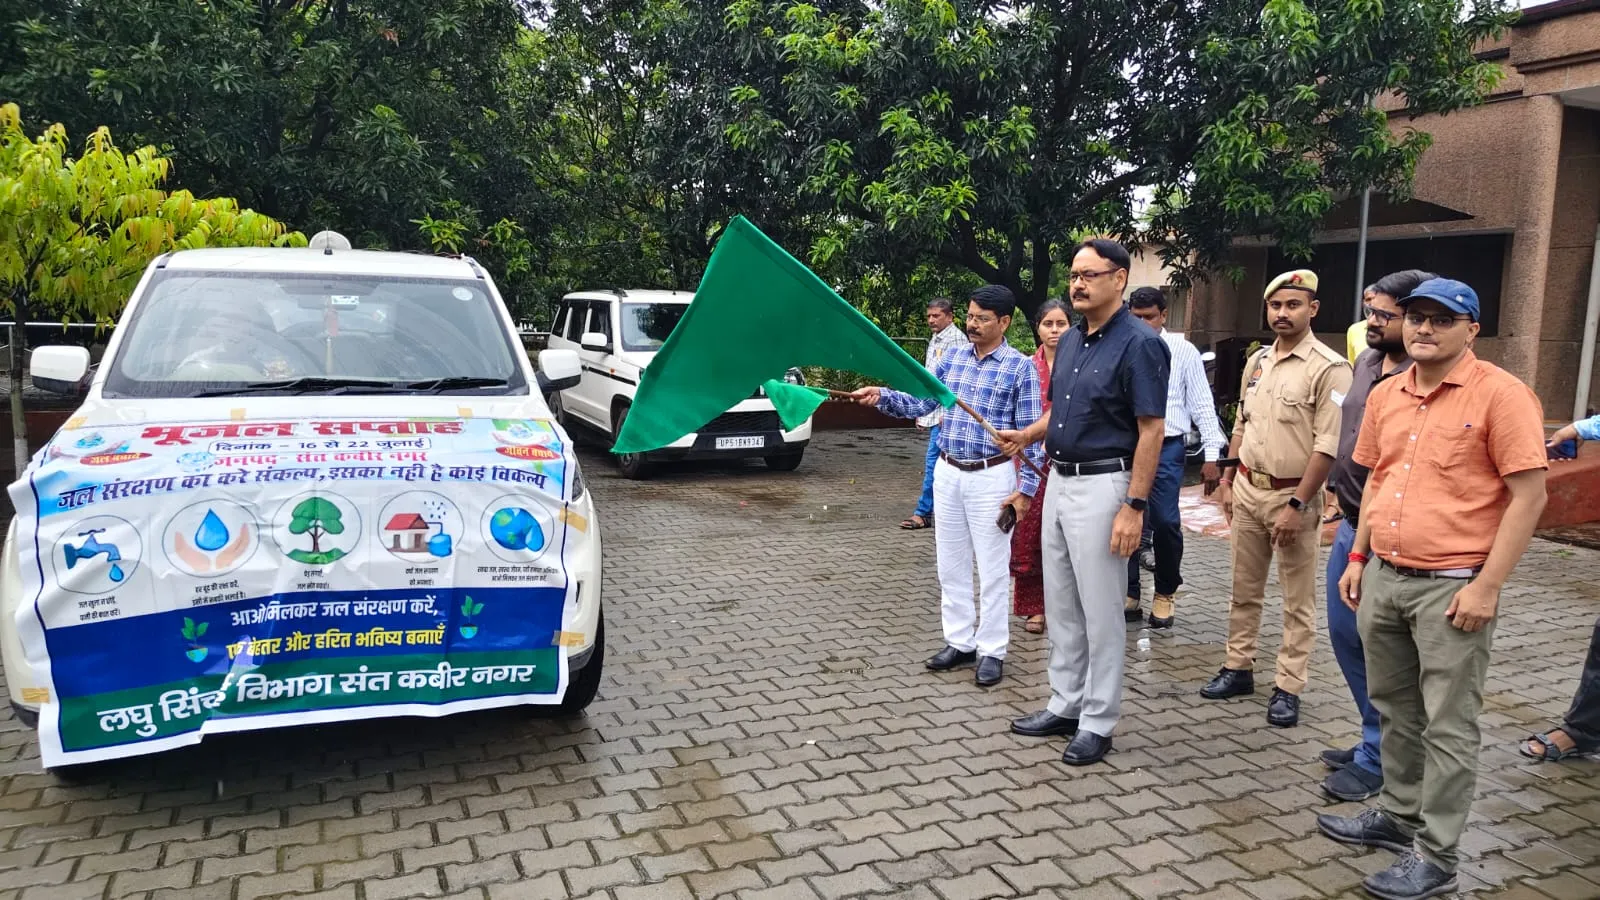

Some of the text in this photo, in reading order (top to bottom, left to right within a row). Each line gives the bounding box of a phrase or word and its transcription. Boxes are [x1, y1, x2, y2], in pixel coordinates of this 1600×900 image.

[141, 421, 464, 446] भूजल सप्ताह
[215, 441, 272, 451] दिनांक
[324, 439, 339, 448] से
[349, 440, 369, 448] 22
[376, 438, 425, 449] जुलाई
[296, 451, 327, 463] संत
[334, 450, 383, 461] कबीर
[389, 451, 428, 461] नगर
[59, 485, 97, 507] जल
[102, 477, 176, 500] संरक्षण
[181, 474, 213, 489] का
[430, 464, 445, 482] है
[491, 465, 548, 490] विकल्प
[320, 602, 350, 617] जल
[353, 597, 408, 616] संरक्षण
[409, 595, 438, 616] करें,
[285, 631, 312, 652] और
[314, 628, 352, 649] हरित
[355, 627, 403, 647] भविष्य
[405, 622, 446, 645] बनाएँ
[97, 703, 158, 737] लघु
[236, 673, 334, 702] विभाग
[339, 665, 393, 693] संत
[397, 661, 470, 689] कबीर
[471, 664, 536, 684] नगर
